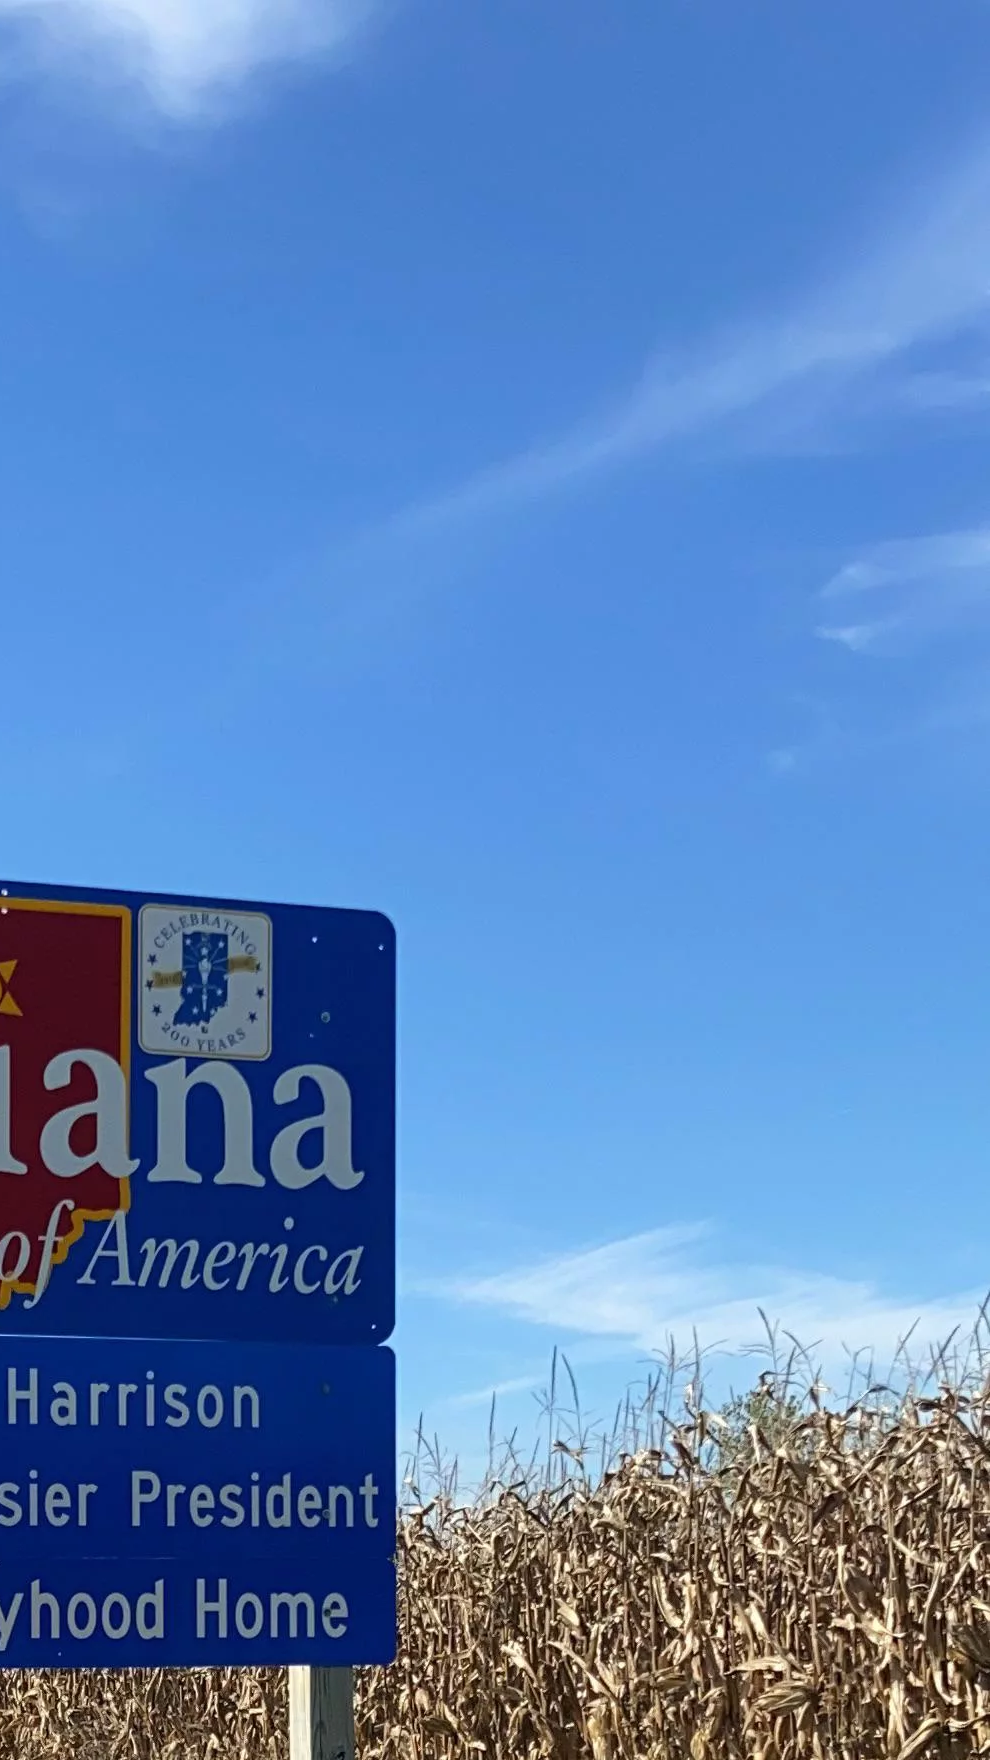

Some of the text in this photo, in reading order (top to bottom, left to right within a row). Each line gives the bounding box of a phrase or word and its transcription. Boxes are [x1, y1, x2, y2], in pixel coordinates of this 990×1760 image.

[153, 911, 257, 956] CELEBRATING
[161, 1022, 246, 1052] 200 YEARS
[76, 1209, 364, 1295] America
[7, 1367, 260, 1428] Harrison
[131, 1470, 379, 1528] President
[196, 1578, 349, 1639] Home
